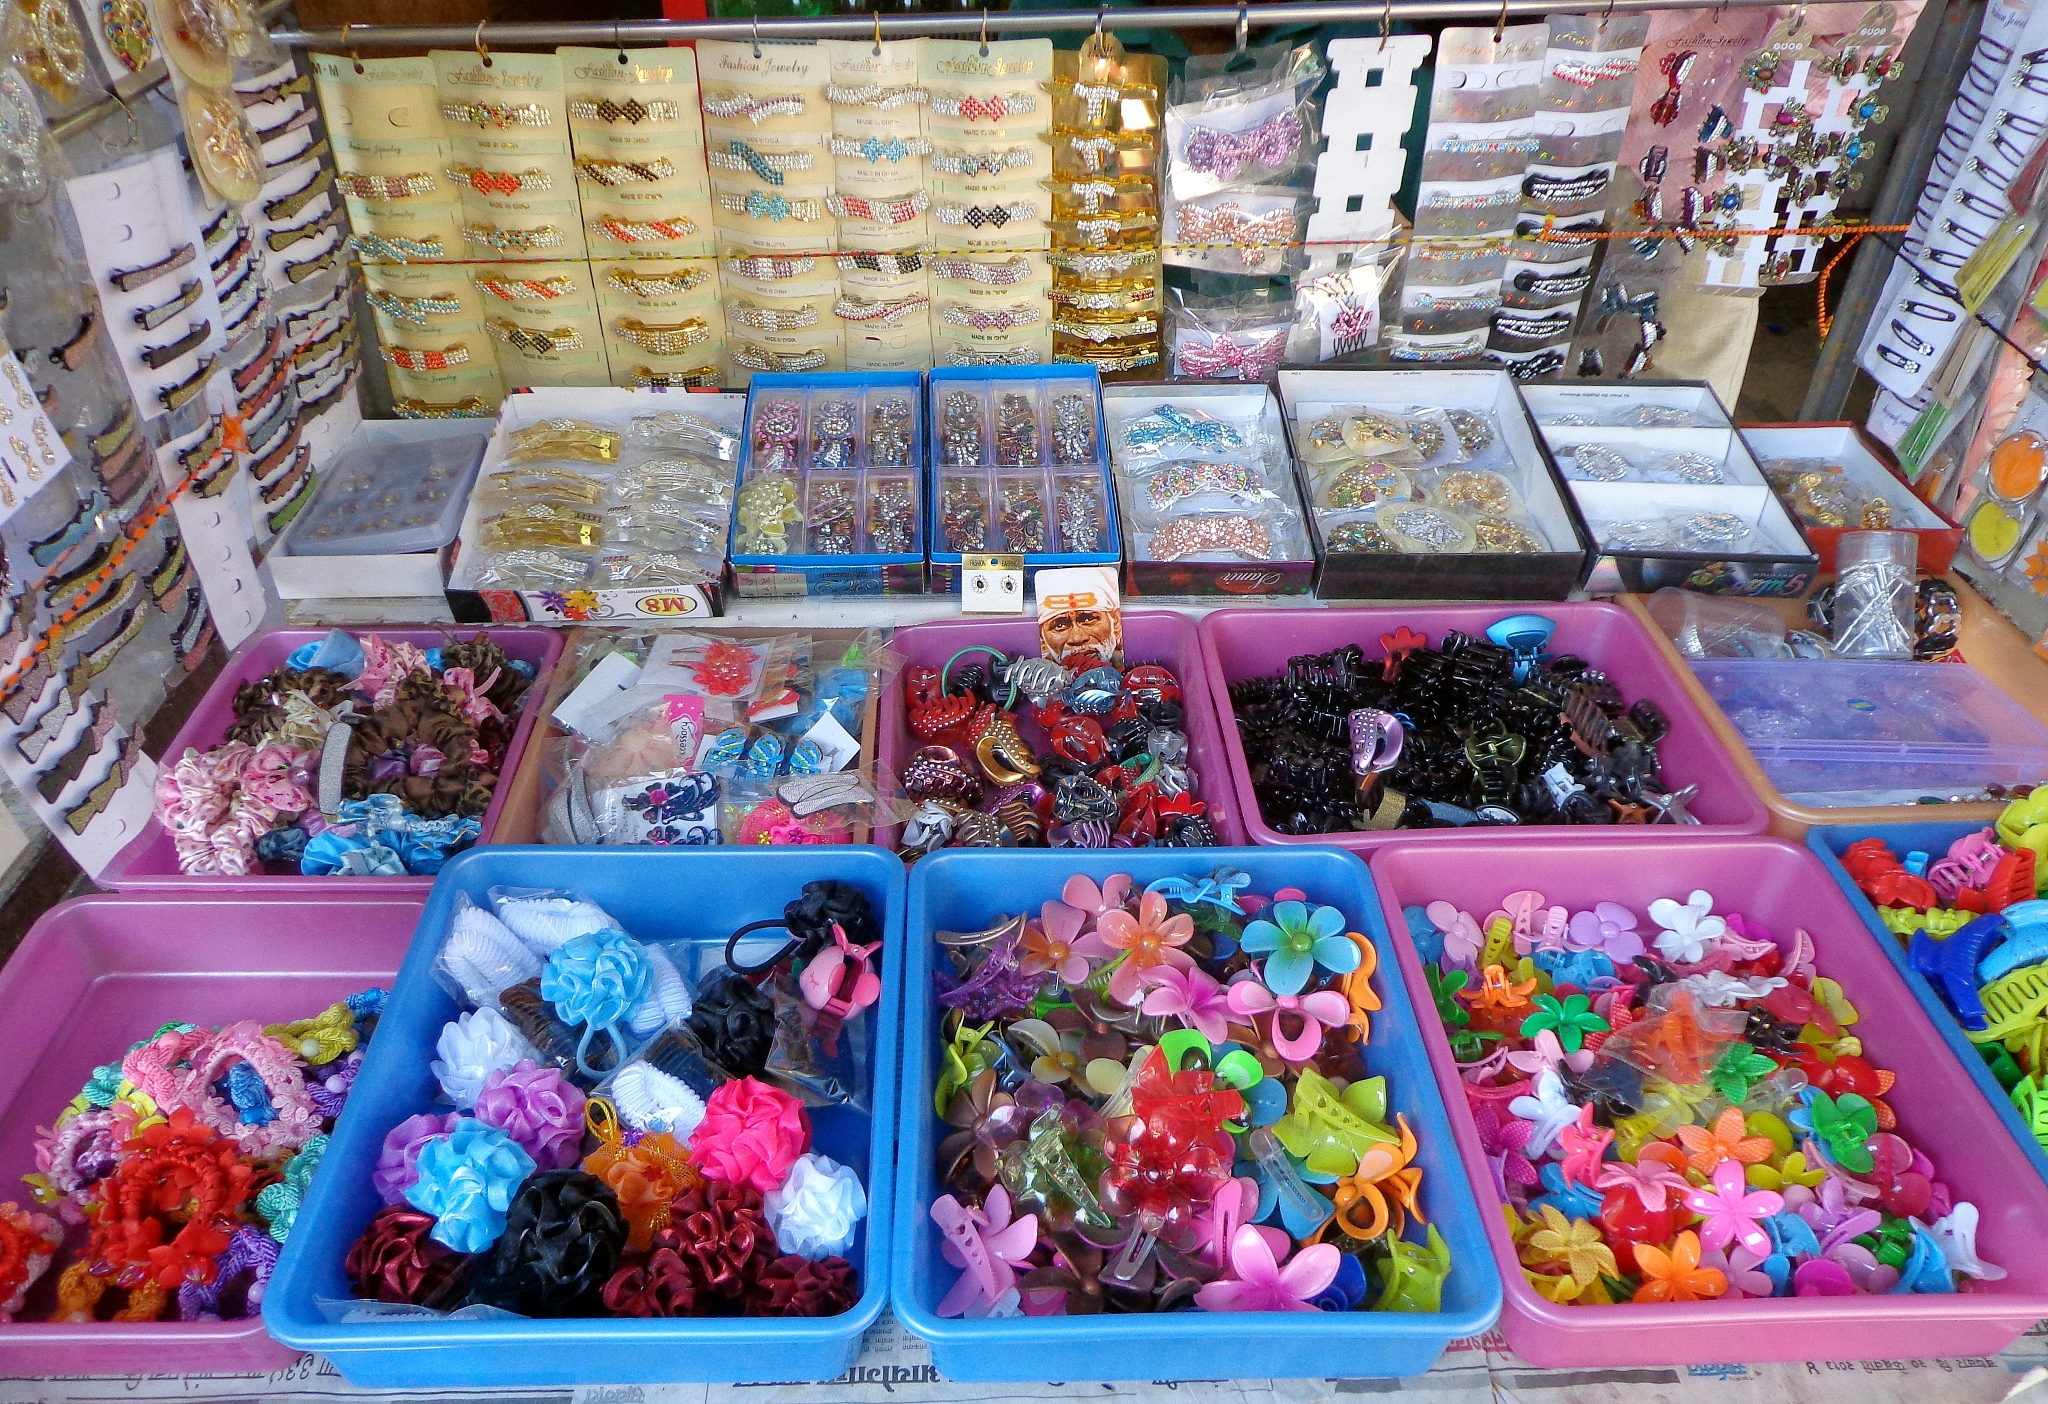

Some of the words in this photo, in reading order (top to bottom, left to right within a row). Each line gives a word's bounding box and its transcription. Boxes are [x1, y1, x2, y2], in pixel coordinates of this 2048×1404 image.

[1666, 33, 1711, 47] Fashion
[1710, 35, 1750, 49] Jewelry
[573, 60, 625, 82] Fashion
[624, 63, 673, 83] Jewelry
[719, 54, 760, 72] Fashion
[761, 57, 811, 77] Jewelry
[937, 55, 988, 74] Fashion
[987, 57, 1034, 77] Jewelry
[447, 67, 494, 87] Fashion
[495, 70, 542, 88] Jewelry
[1219, 571, 1284, 591] Samir
[645, 596, 688, 613] M8
[1825, 1360, 1854, 1371] २०१३
[1911, 1359, 1928, 1369] २०
[1956, 1356, 1998, 1369] बुधवार
